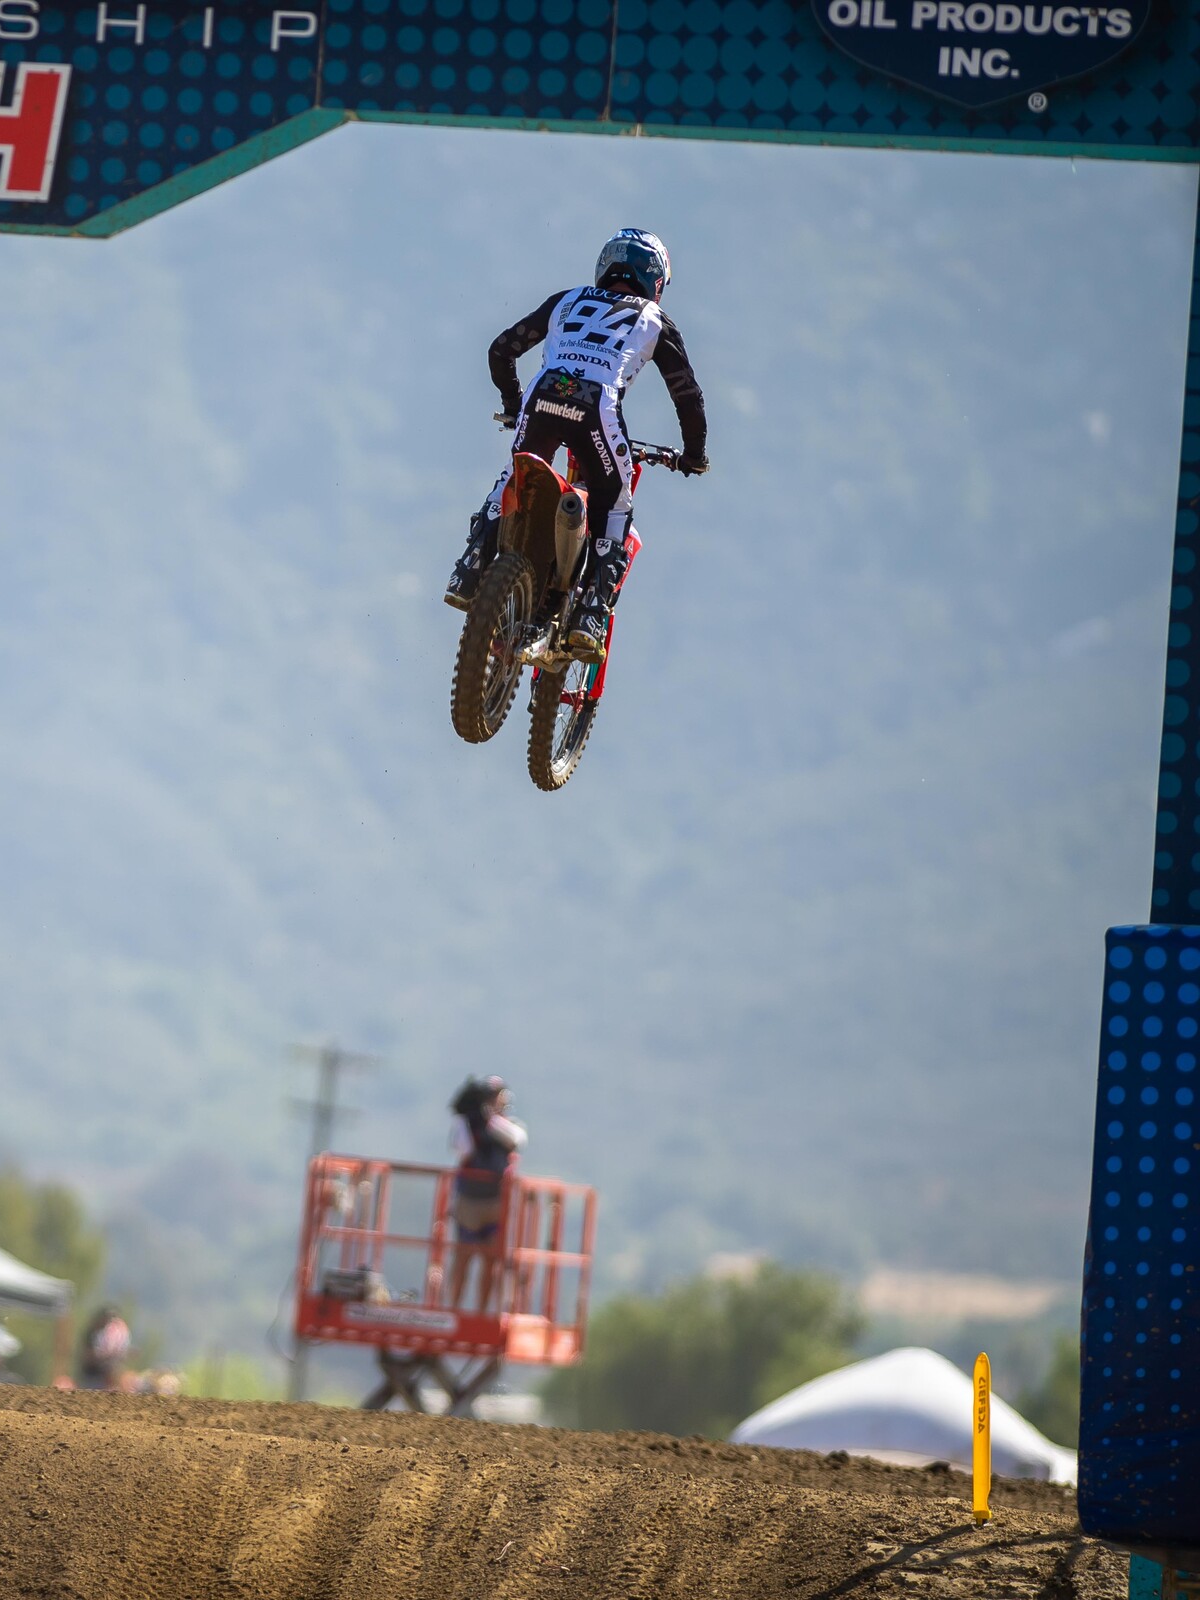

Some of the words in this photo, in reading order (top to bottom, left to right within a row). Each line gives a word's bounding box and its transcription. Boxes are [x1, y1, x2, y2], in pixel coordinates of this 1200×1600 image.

[828, 0, 897, 28] OIL
[911, 1, 1132, 38] PRODUCTS
[938, 46, 1020, 79] INC.
[563, 299, 639, 351] 94
[556, 353, 612, 371] HONDA
[590, 429, 614, 476] HONDA
